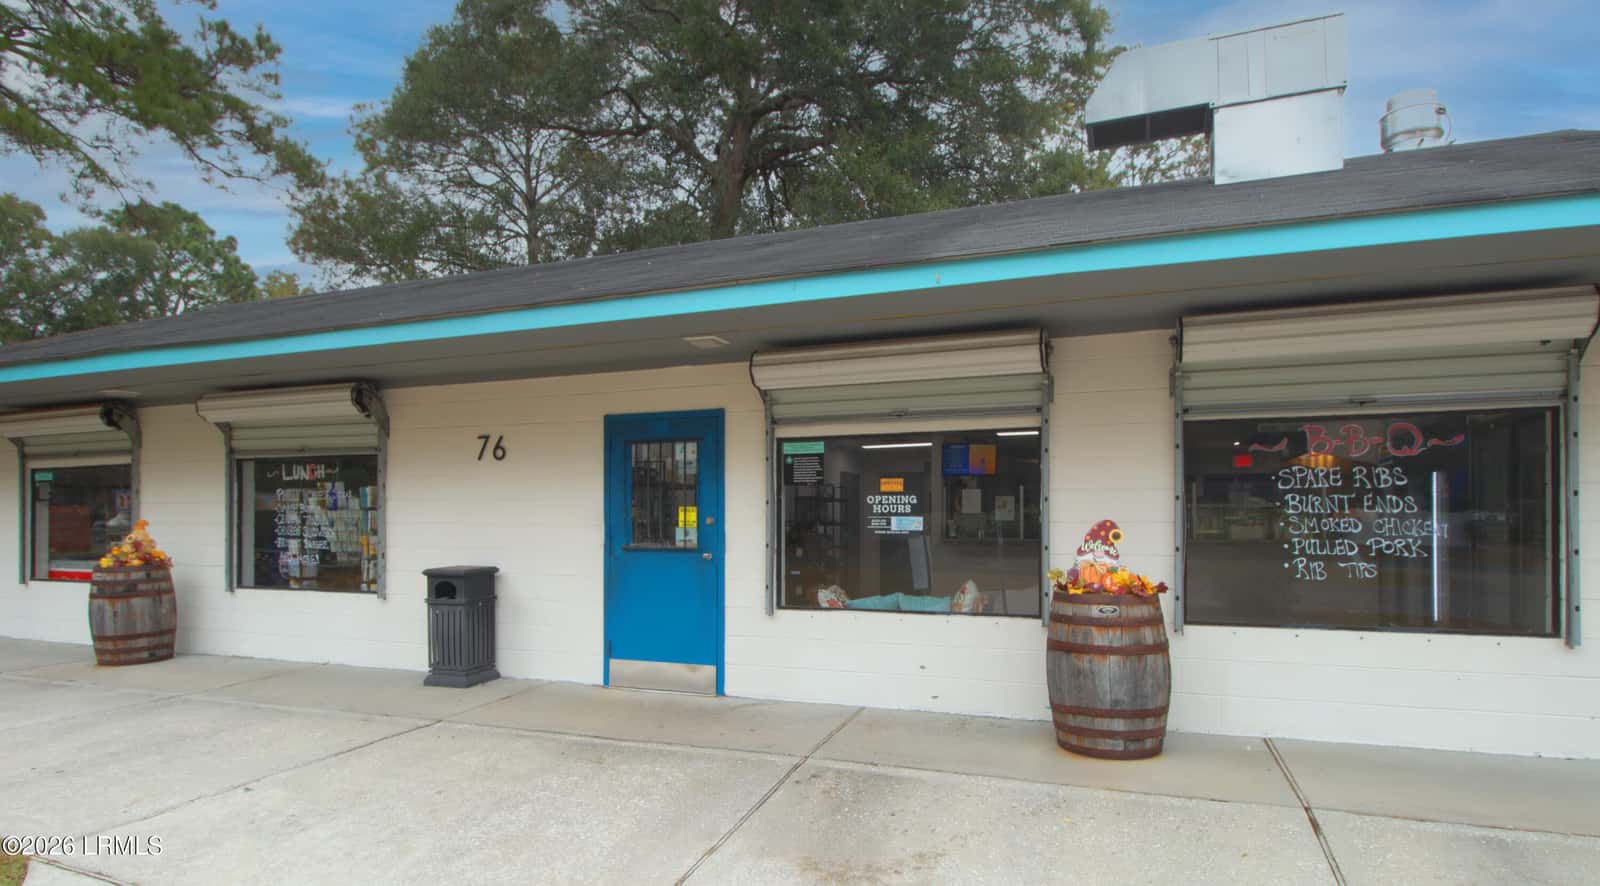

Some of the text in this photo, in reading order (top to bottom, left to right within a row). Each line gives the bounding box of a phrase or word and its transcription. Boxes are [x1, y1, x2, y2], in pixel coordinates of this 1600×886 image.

[477, 435, 507, 461] 76
[281, 463, 325, 481] LUNCH
[1278, 466, 1408, 489] SPARE RIBS
[866, 495, 917, 504] OPENING
[872, 504, 912, 513] HOURS
[1285, 493, 1417, 514] BURNT ENDS
[1288, 516, 1362, 535] SMOKED
[1292, 537, 1428, 558] PULLED PORK
[1293, 557, 1377, 580] RIB TIPS
